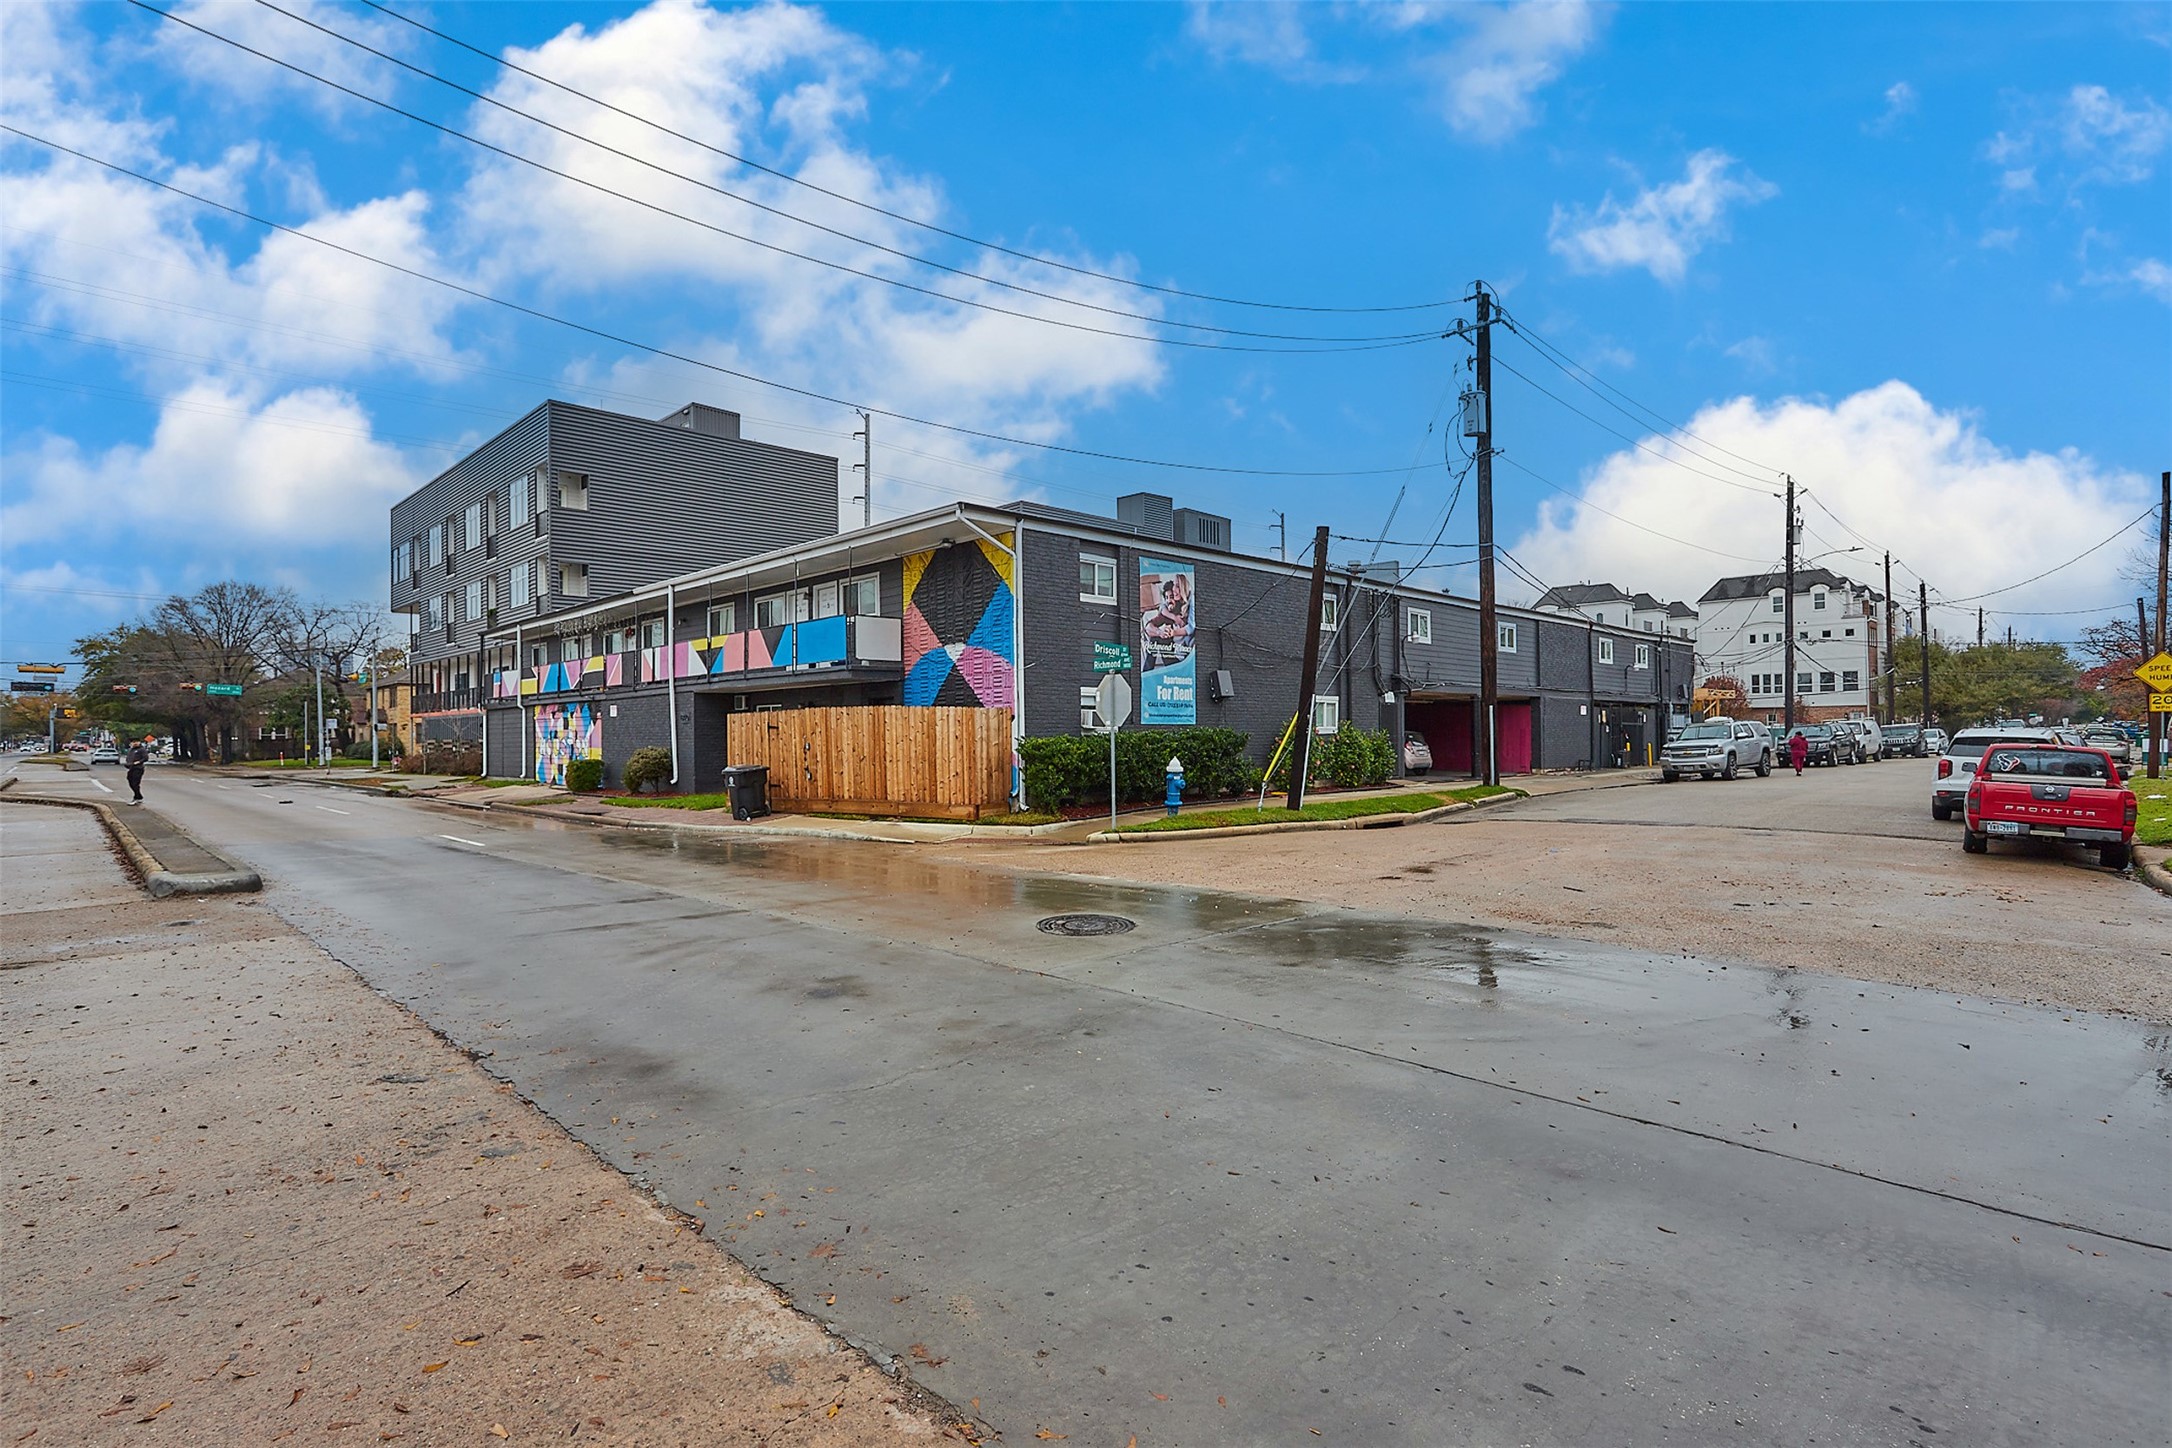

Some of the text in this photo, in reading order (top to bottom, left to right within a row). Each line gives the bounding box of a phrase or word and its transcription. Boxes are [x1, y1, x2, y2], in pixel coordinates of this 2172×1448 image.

[1095, 644, 1120, 656] Driscoll
[1145, 641, 1173, 654] Richmond
[1094, 659, 1121, 670] Richmond
[1163, 675, 1193, 685] Apartments
[1157, 685, 1193, 701] For Rent
[2152, 695, 2172, 705] 20
[2005, 805, 2095, 816] FRONTIER
